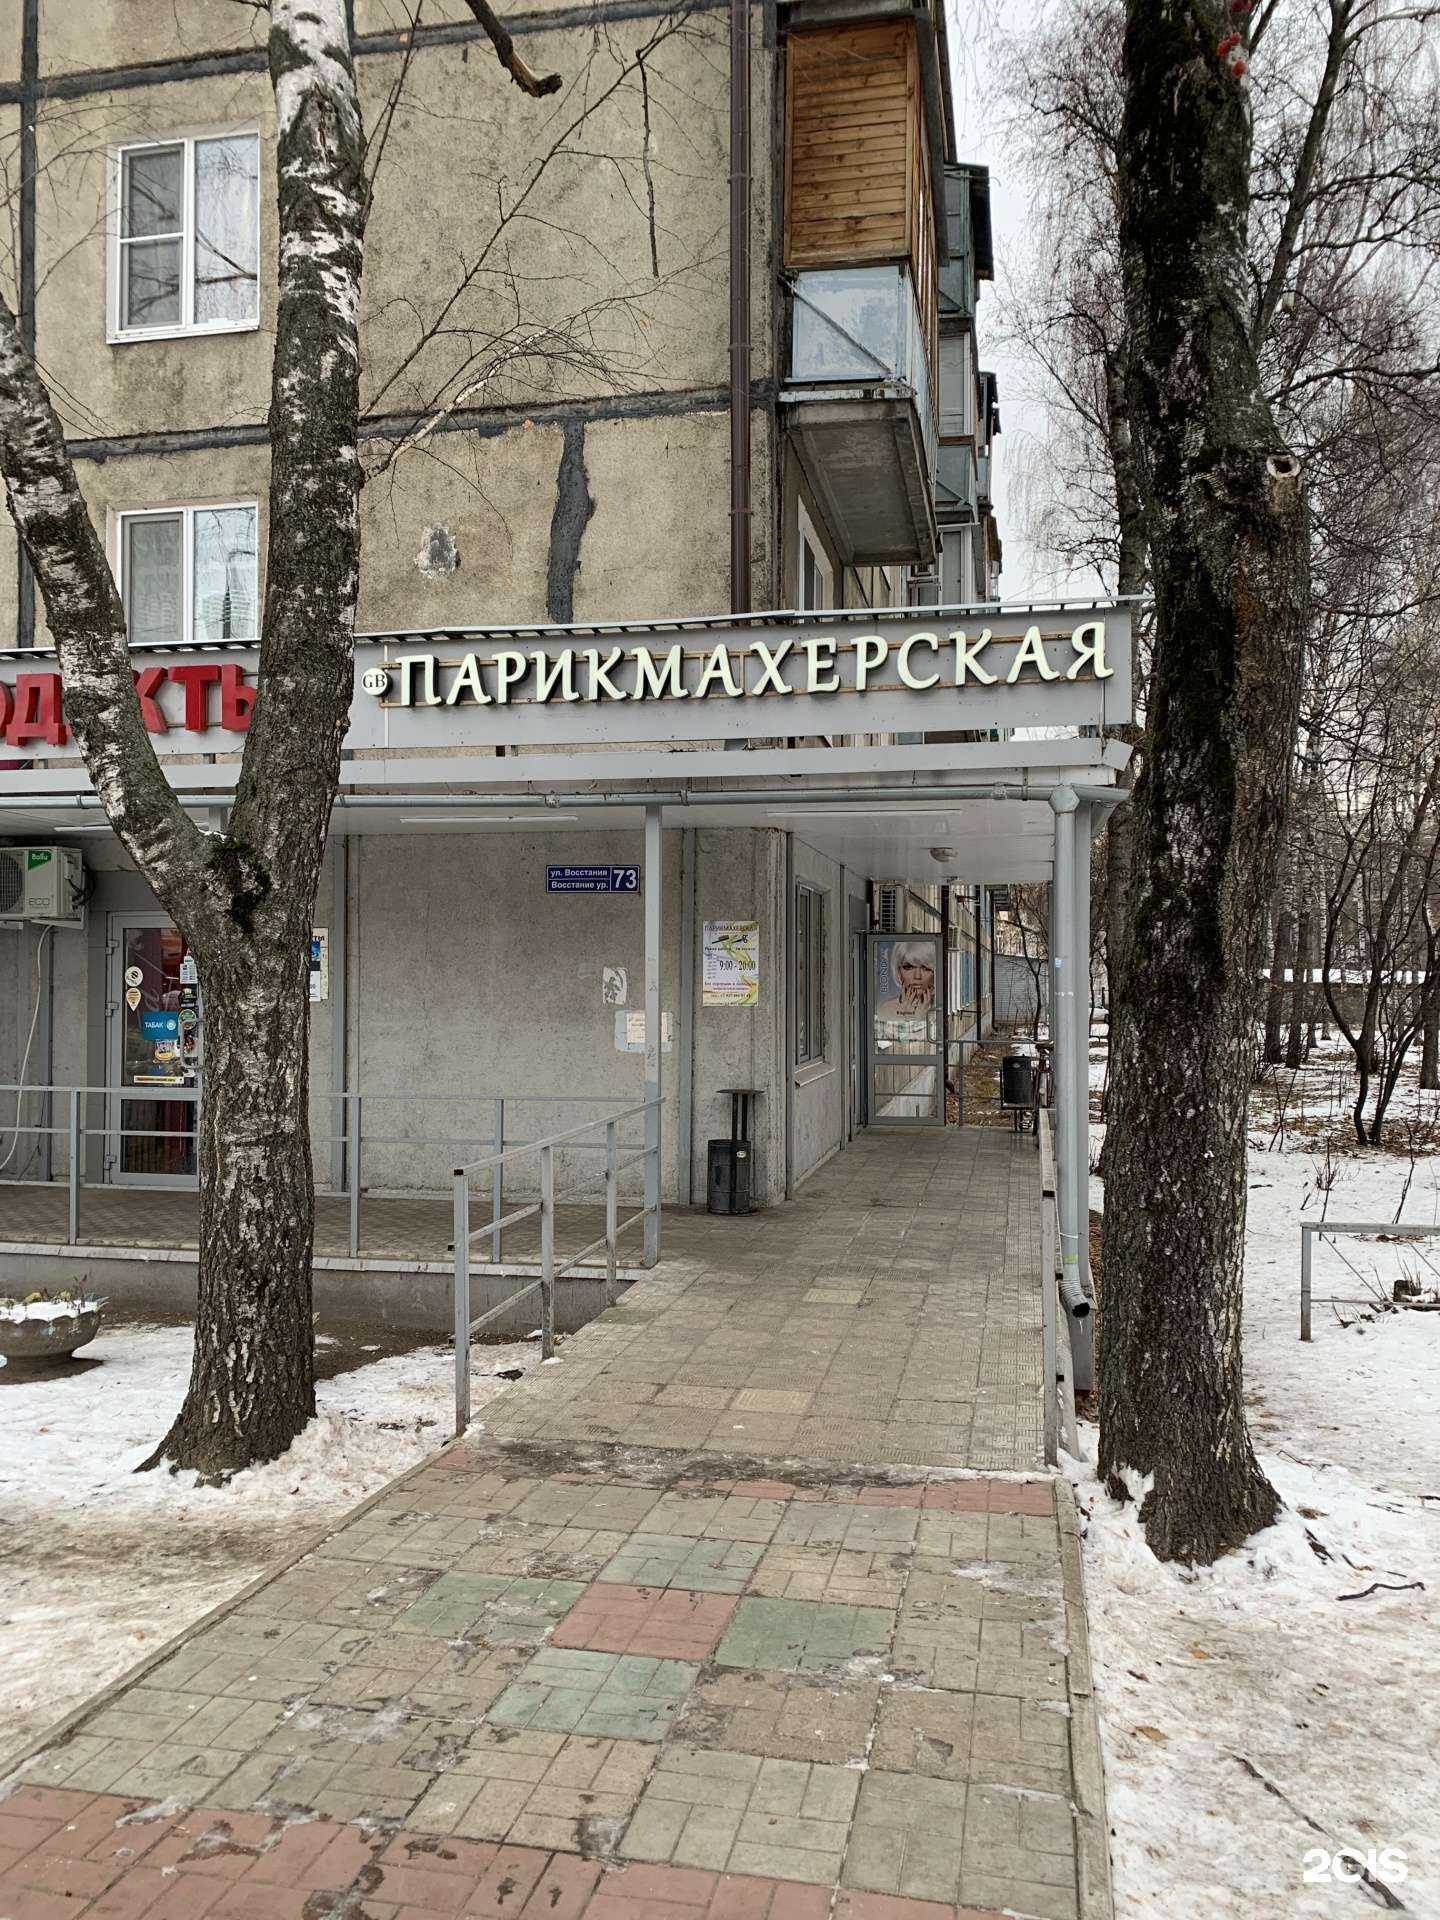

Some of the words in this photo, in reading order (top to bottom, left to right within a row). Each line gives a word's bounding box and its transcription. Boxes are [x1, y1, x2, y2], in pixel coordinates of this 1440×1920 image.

[395, 621, 1115, 707] ПАРИКМАХЕРСКАЯ
[362, 674, 386, 688] GB
[550, 870, 563, 878] ул.
[565, 868, 608, 876] Восстания
[613, 869, 637, 889] 73
[551, 881, 595, 889] Восстание
[596, 882, 609, 890] ур.
[144, 1021, 164, 1029] ТАБАК
